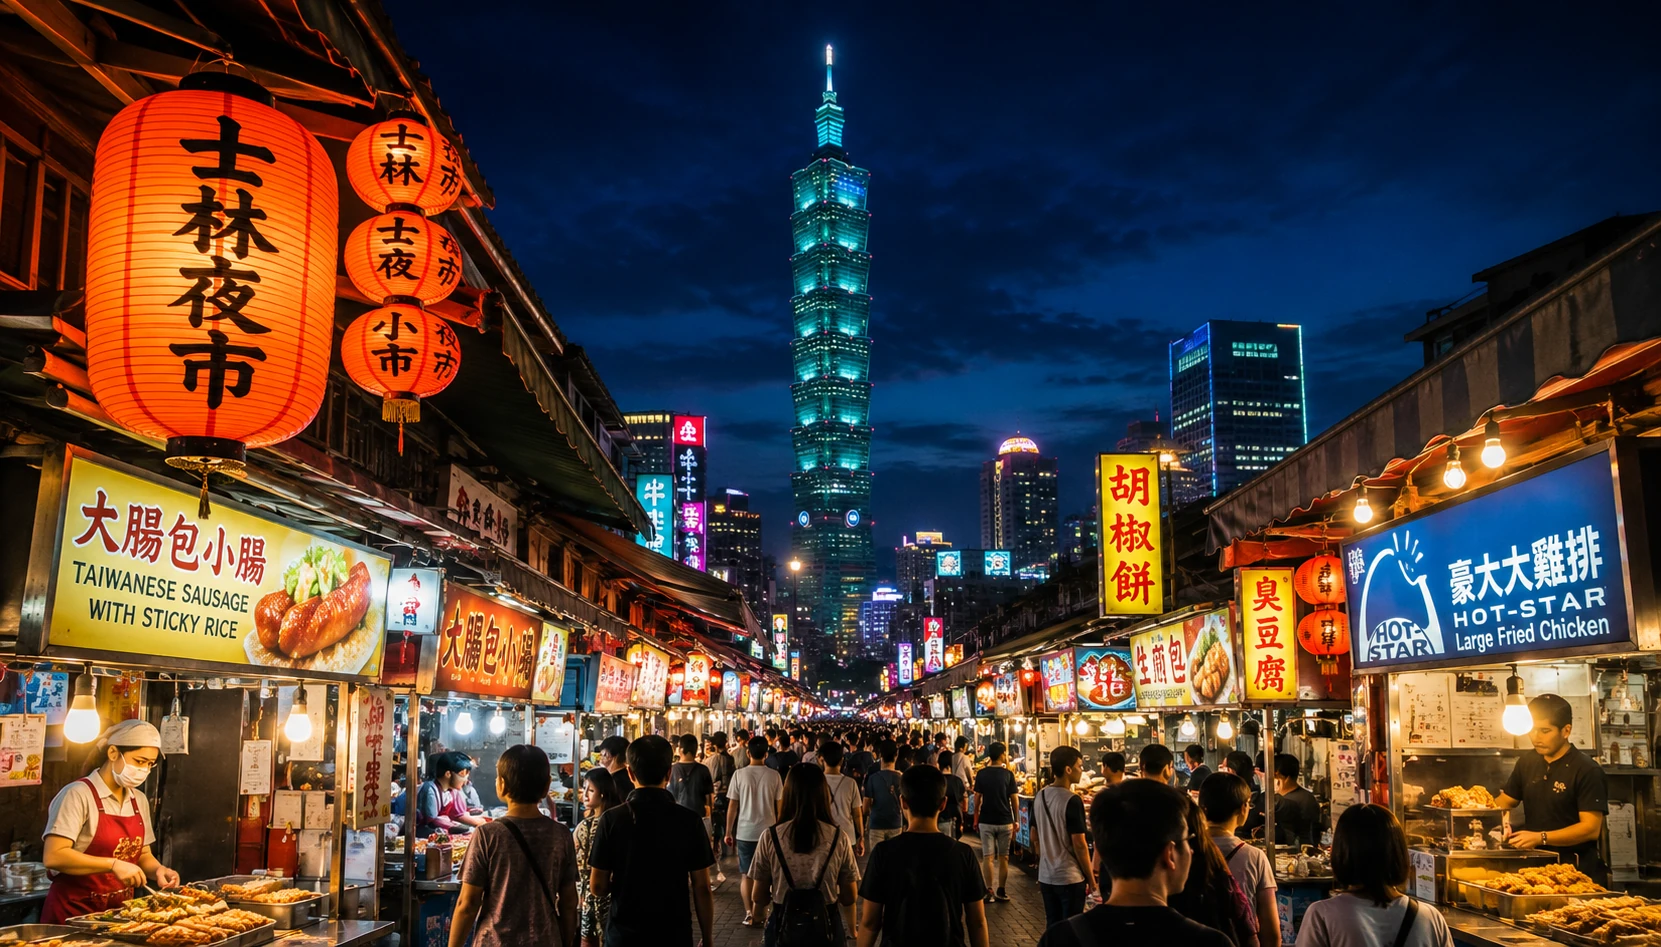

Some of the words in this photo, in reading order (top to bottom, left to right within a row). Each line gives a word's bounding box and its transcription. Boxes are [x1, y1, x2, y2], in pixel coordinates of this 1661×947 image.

[380, 124, 424, 186] 士林
[167, 115, 279, 410] 士林夜市
[376, 217, 420, 280] 士夜
[371, 312, 418, 377] 小市
[73, 488, 267, 587] 大腸包小腸
[1108, 464, 1156, 606] 胡椒餅
[1448, 524, 1604, 607] 豪大大雞排
[73, 560, 176, 601] TAIWANESE
[182, 583, 249, 614] SAUSAGE
[1453, 587, 1606, 628] HOT-STAR
[89, 599, 135, 626] WITH
[142, 606, 200, 635] STICKY
[204, 616, 238, 639] RICE
[1252, 575, 1286, 693] 臭豆腐
[1370, 639, 1432, 661] STAR
[1376, 618, 1422, 643] HOT-
[1455, 631, 1494, 653] Large
[1498, 624, 1535, 646] Fried
[1540, 616, 1610, 641] Chicken
